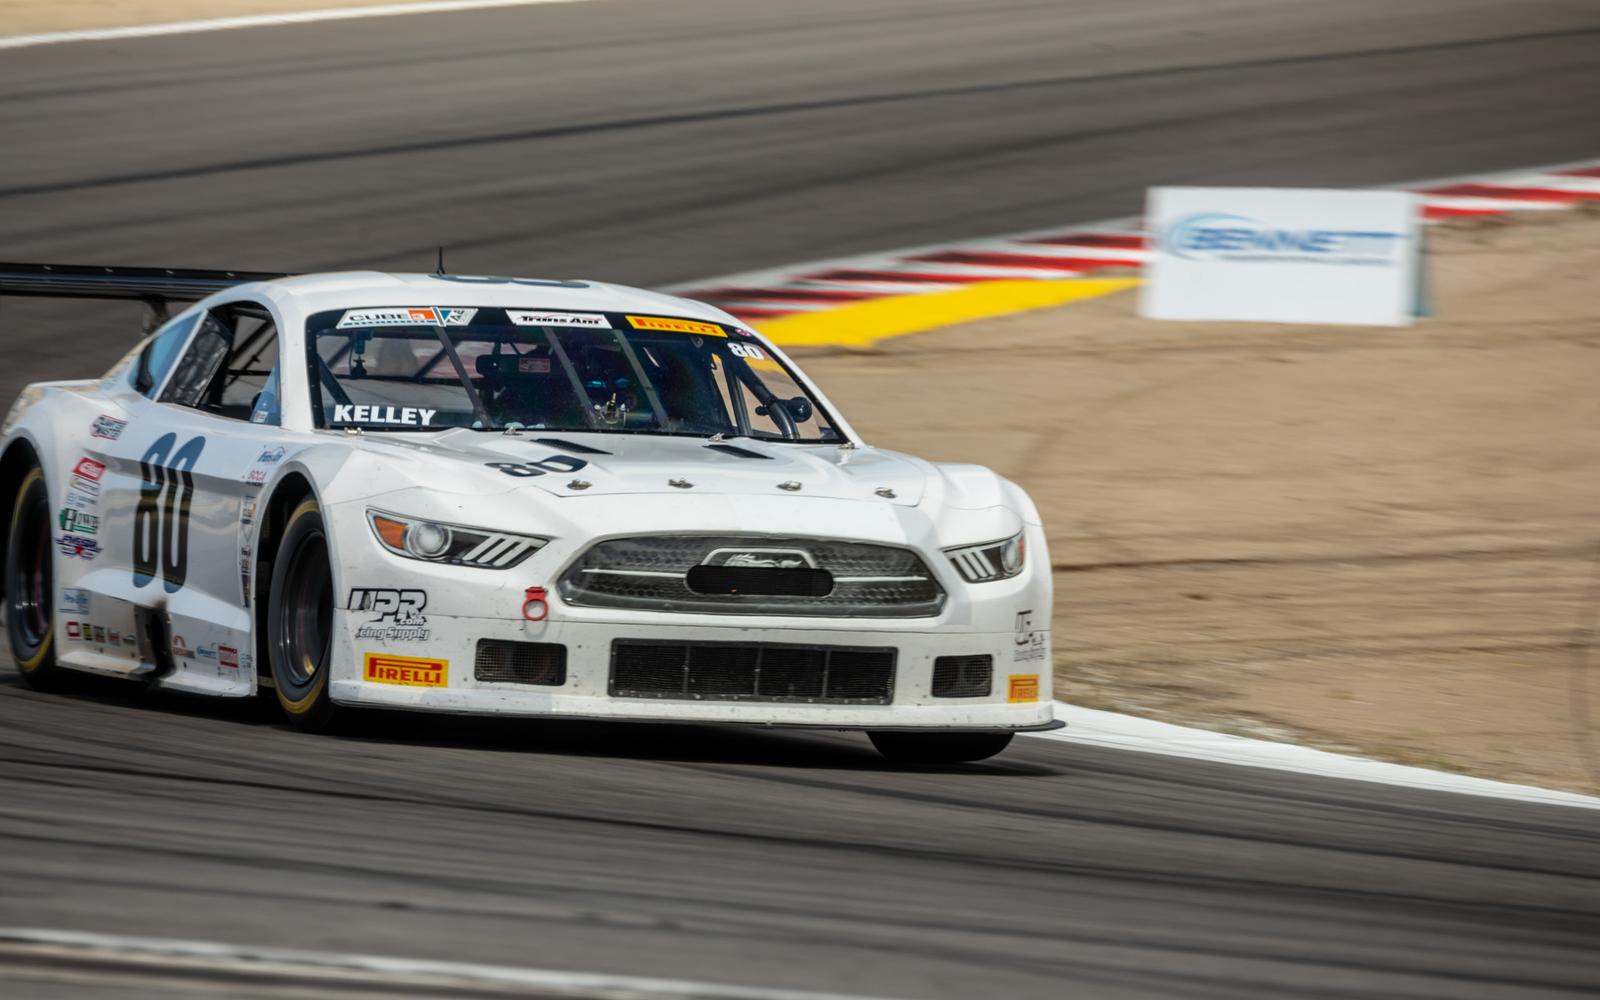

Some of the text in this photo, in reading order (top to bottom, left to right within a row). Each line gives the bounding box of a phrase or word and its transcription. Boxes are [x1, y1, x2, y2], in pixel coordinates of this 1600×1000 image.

[569, 316, 601, 325] Am
[727, 341, 765, 361] 80
[334, 404, 437, 427] KELLEY
[484, 455, 589, 478] 80
[132, 431, 207, 594] 80
[347, 587, 428, 623] UPR
[384, 626, 431, 642] Supply
[369, 656, 443, 684] PIRELLI
